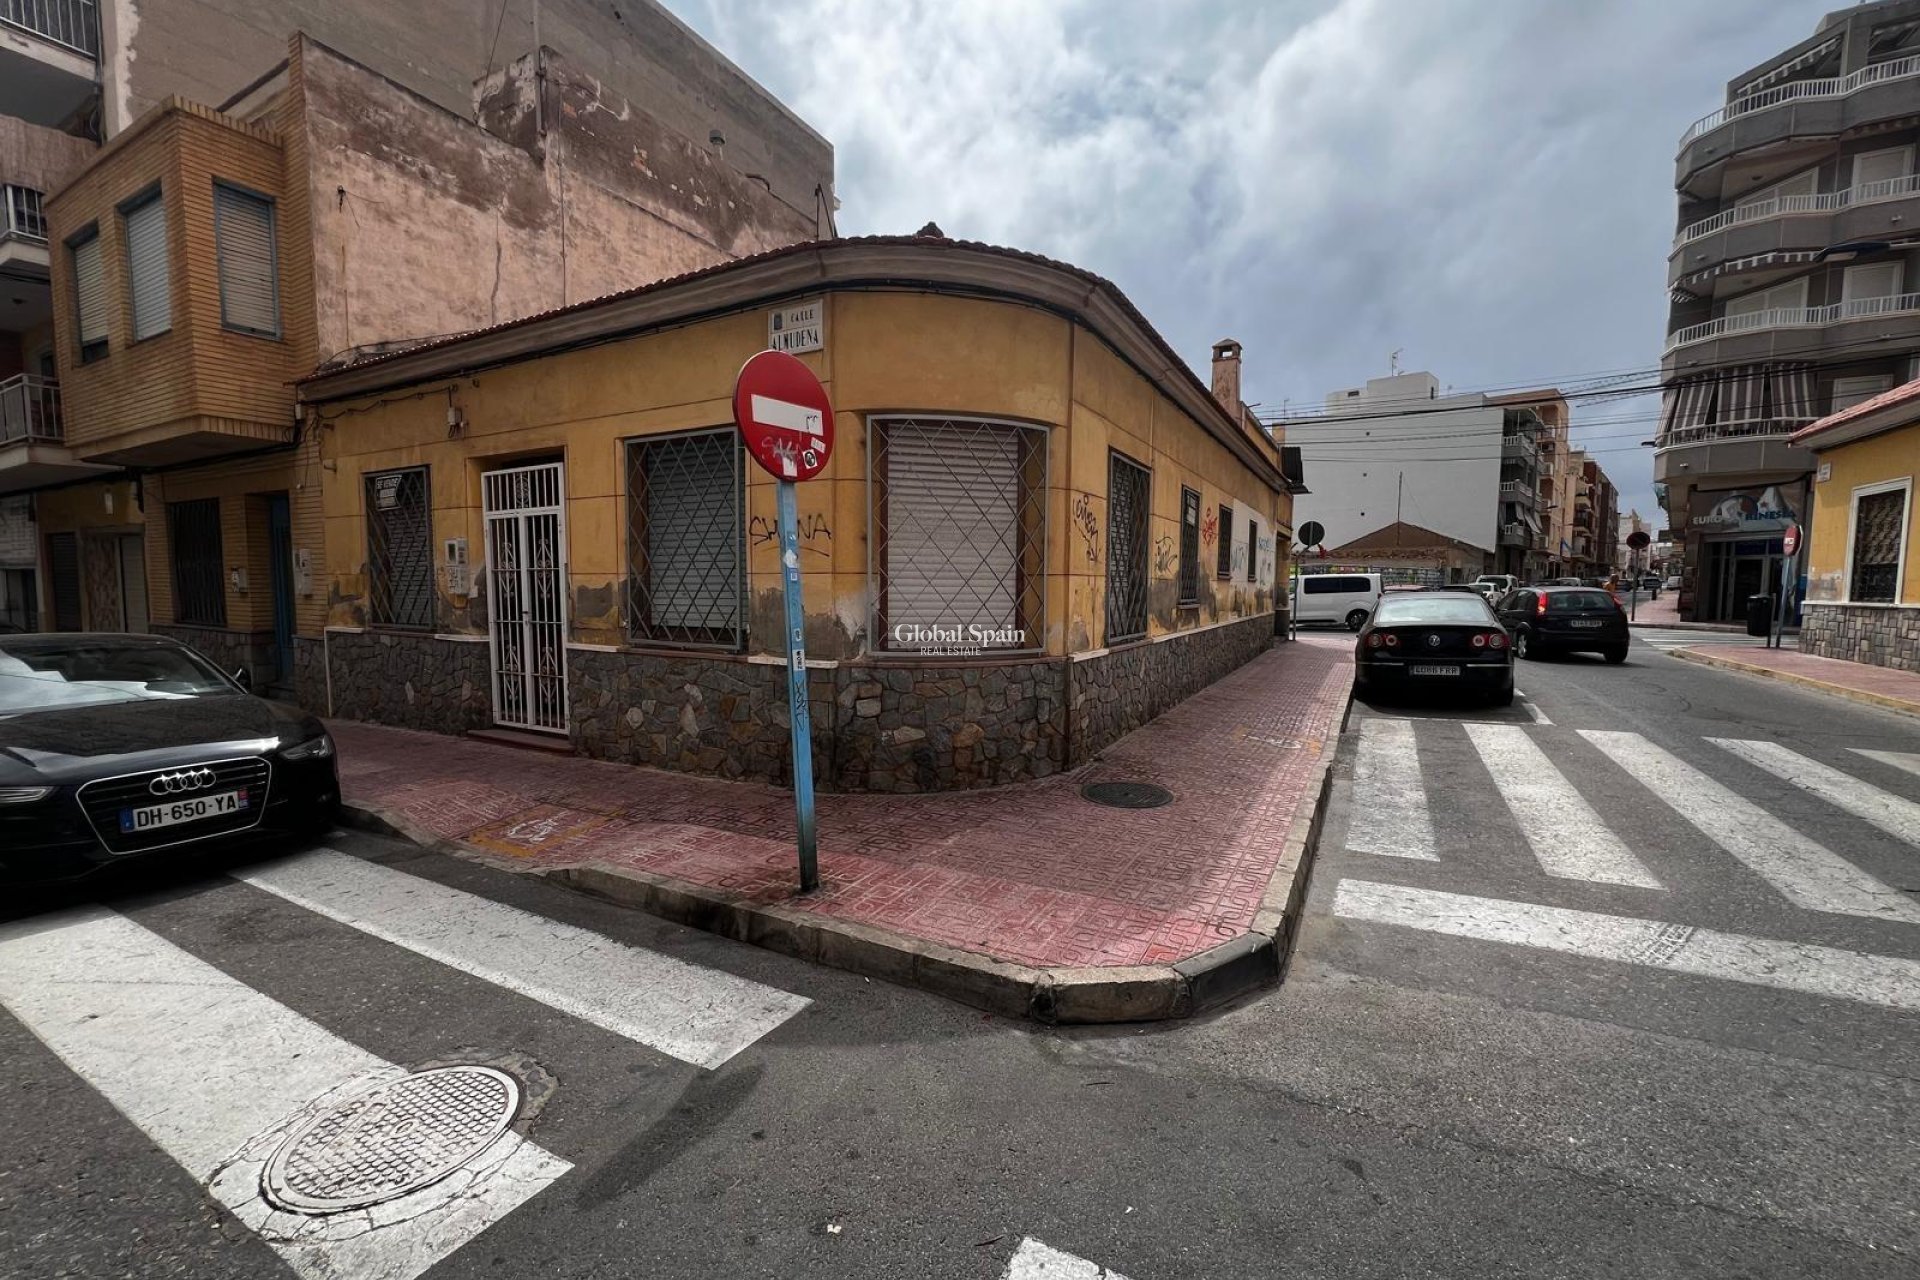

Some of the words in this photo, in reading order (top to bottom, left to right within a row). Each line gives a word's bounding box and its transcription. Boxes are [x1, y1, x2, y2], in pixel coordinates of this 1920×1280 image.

[791, 309, 814, 322] CALLE
[772, 329, 819, 351] ALMUDENA
[137, 795, 236, 828] DH-650-YA
